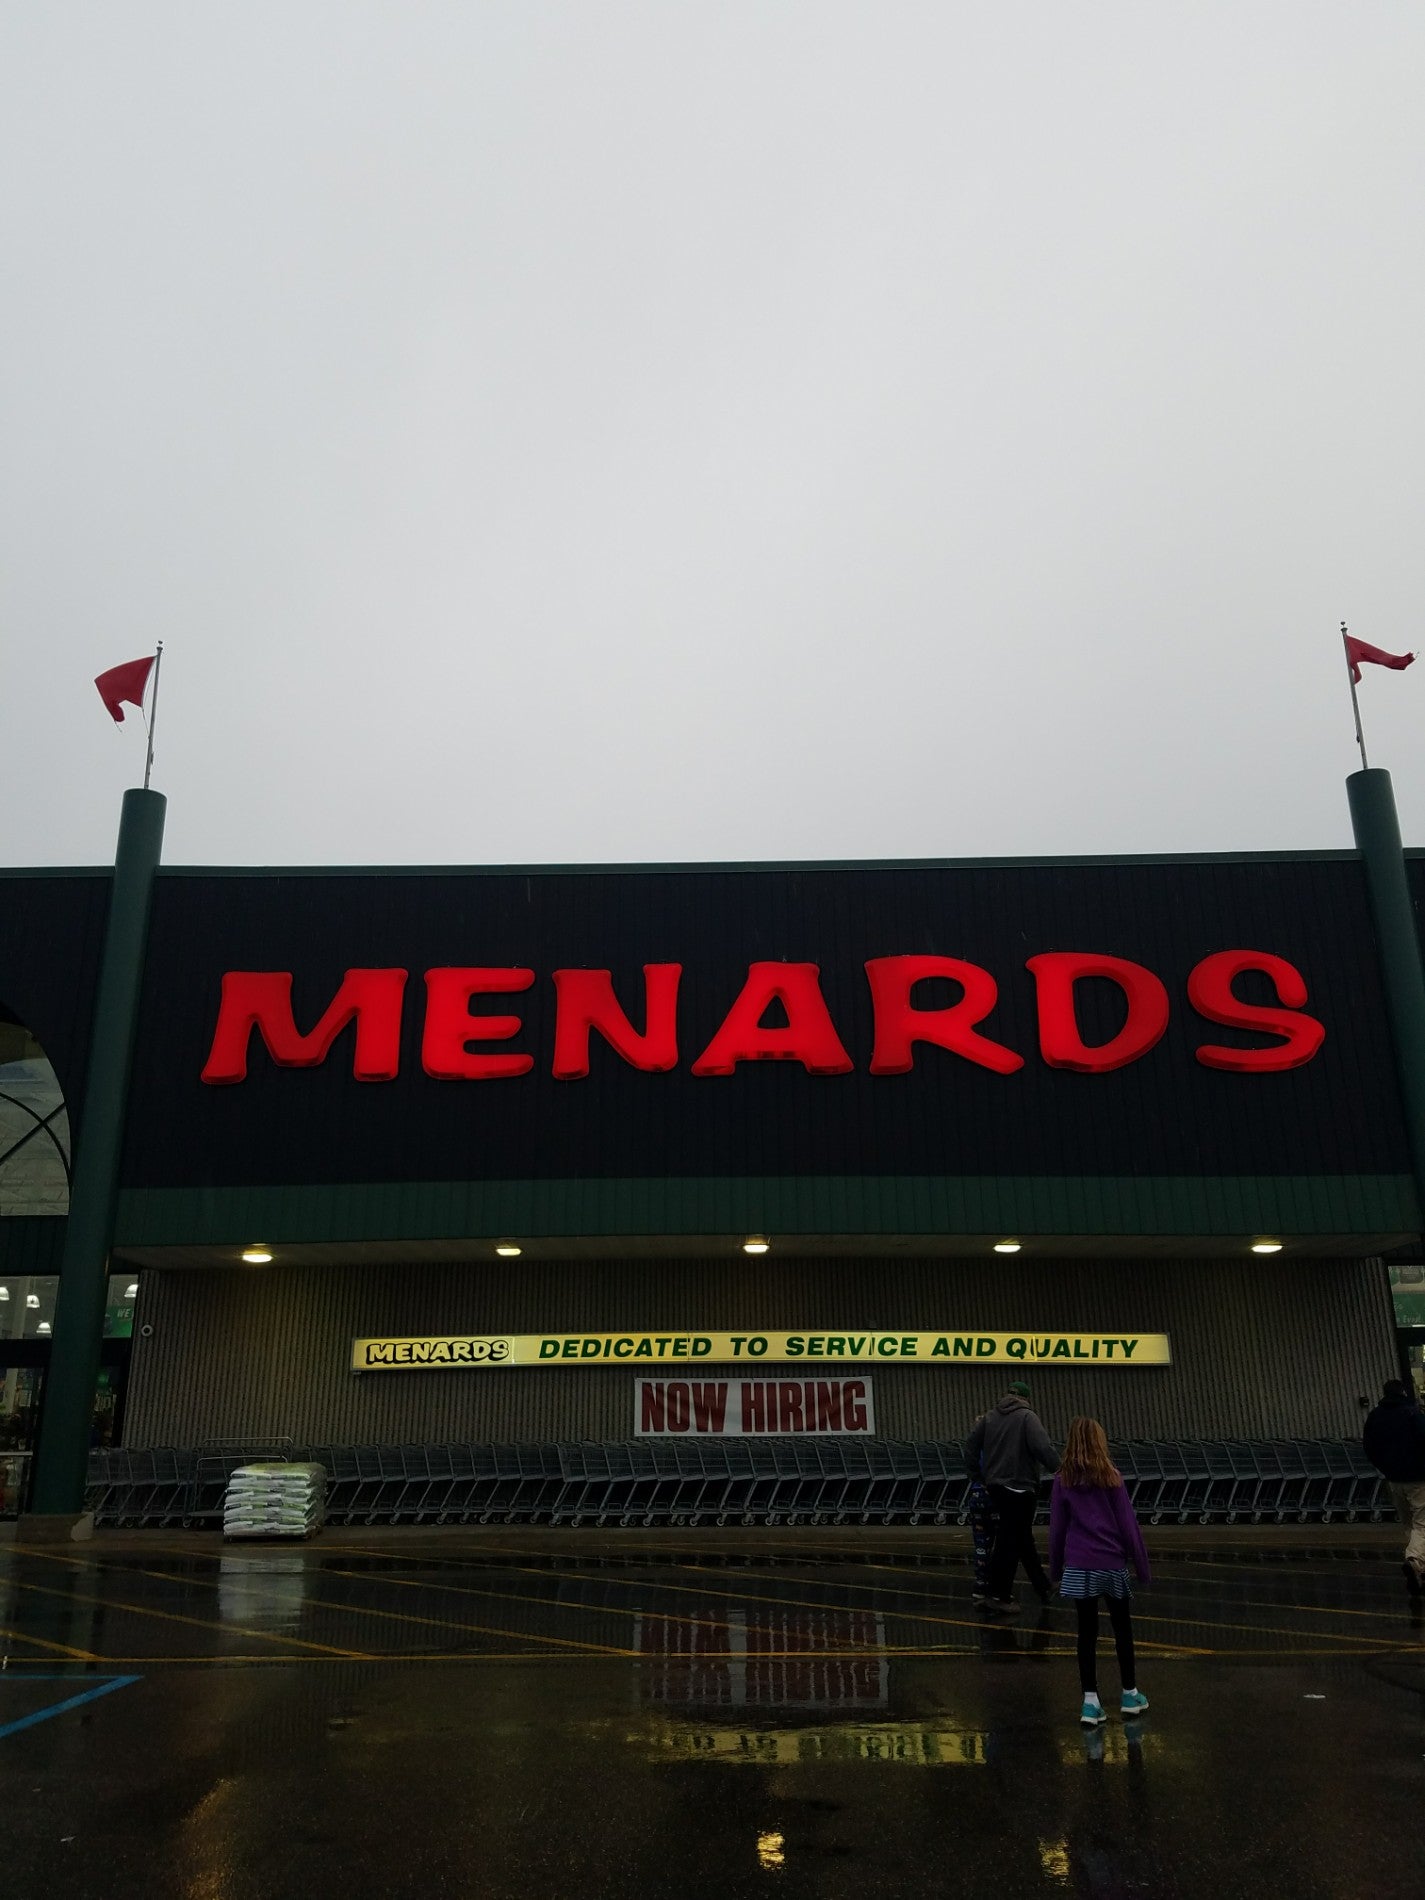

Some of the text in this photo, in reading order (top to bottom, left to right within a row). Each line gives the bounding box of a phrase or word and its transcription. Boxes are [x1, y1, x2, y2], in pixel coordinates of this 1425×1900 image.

[201, 949, 1327, 1084] MENARDS
[365, 1336, 1139, 1365] MENARDS DEDICATED TO SERVICE AND QUALITY
[641, 1381, 867, 1432] NOW HIRING
